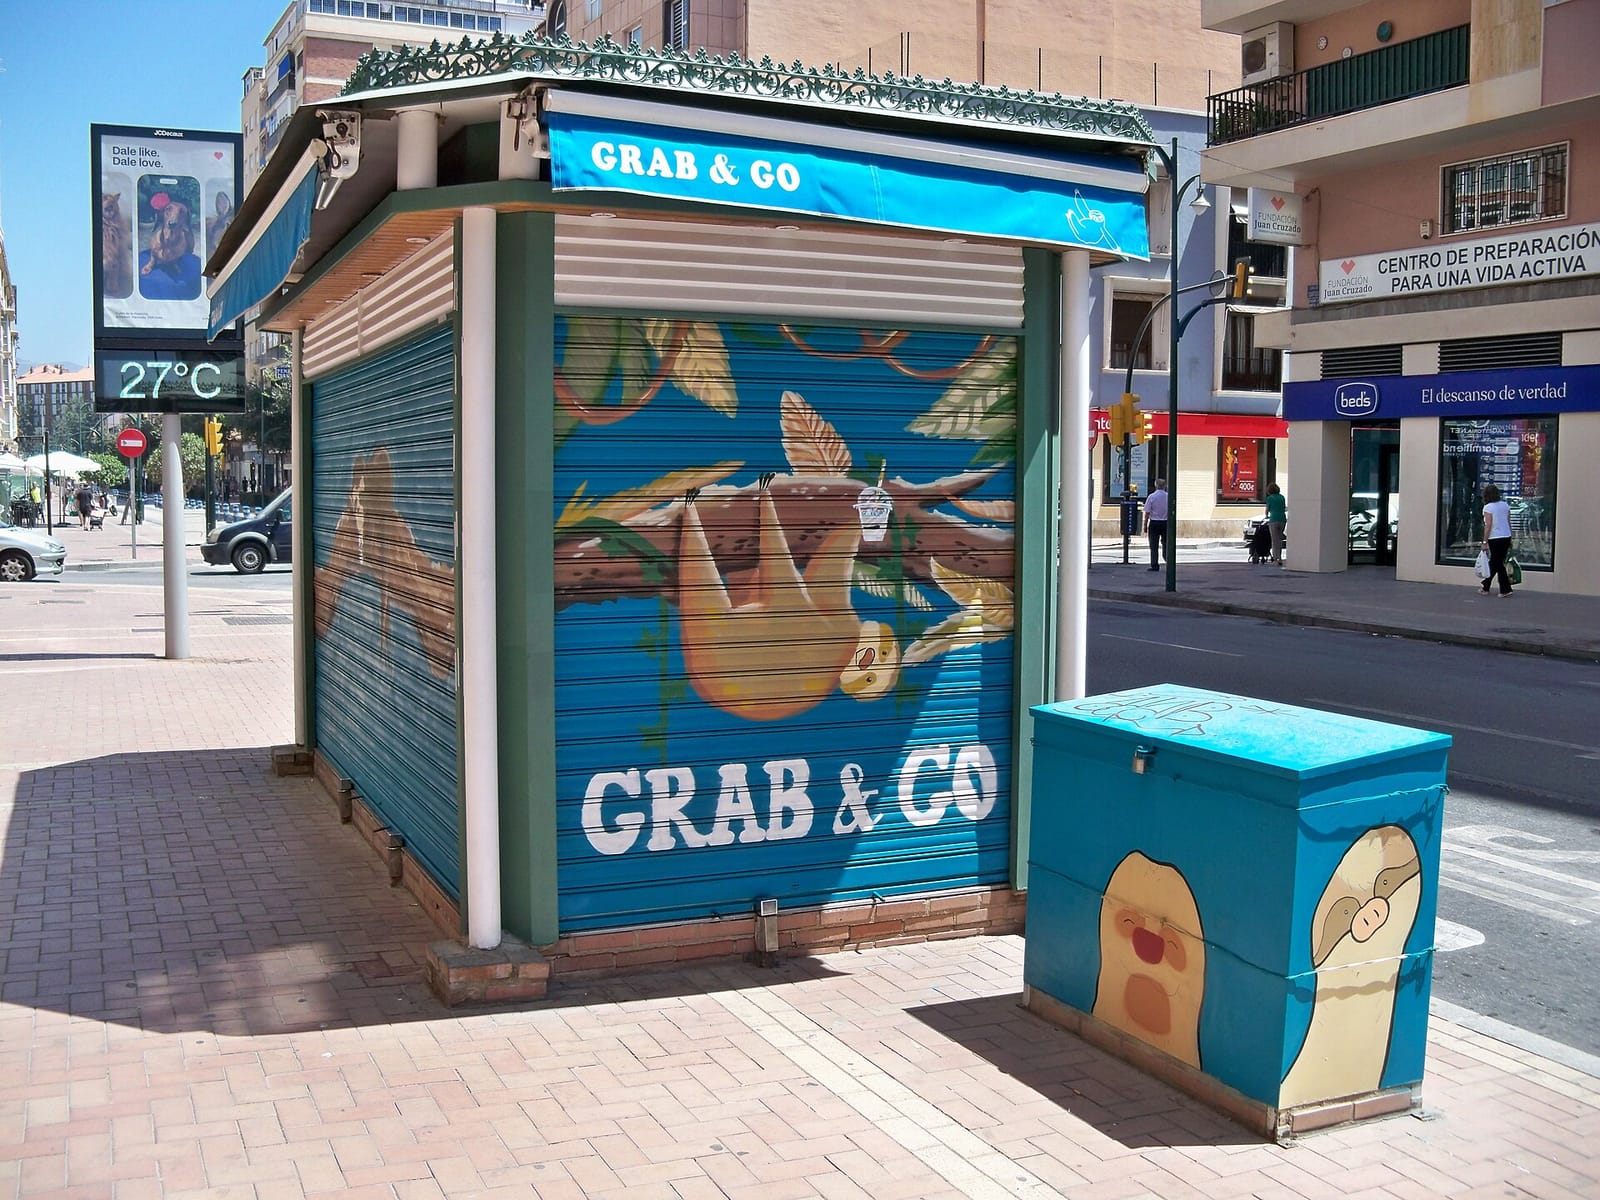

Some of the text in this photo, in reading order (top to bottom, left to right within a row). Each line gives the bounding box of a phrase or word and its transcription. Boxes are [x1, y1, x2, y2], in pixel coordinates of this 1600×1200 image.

[112, 146, 160, 158] Dale like.
[112, 156, 164, 168] Dale love.
[591, 141, 801, 192] GRAB & GO
[1254, 219, 1271, 230] Juan
[1272, 220, 1302, 233] Cruzado
[1378, 227, 1600, 275] CENTRO DE PREPARACIÓN
[1327, 274, 1369, 288] FUNDACIÓN
[1391, 254, 1586, 293] PARA UNA VIDA ACTIVA
[1323, 289, 1341, 300] Juan
[1341, 284, 1373, 295] Cruzado
[119, 361, 221, 399] 27°C
[1421, 382, 1567, 404] El descanso de verdad
[580, 743, 998, 856] GRAB & GO
